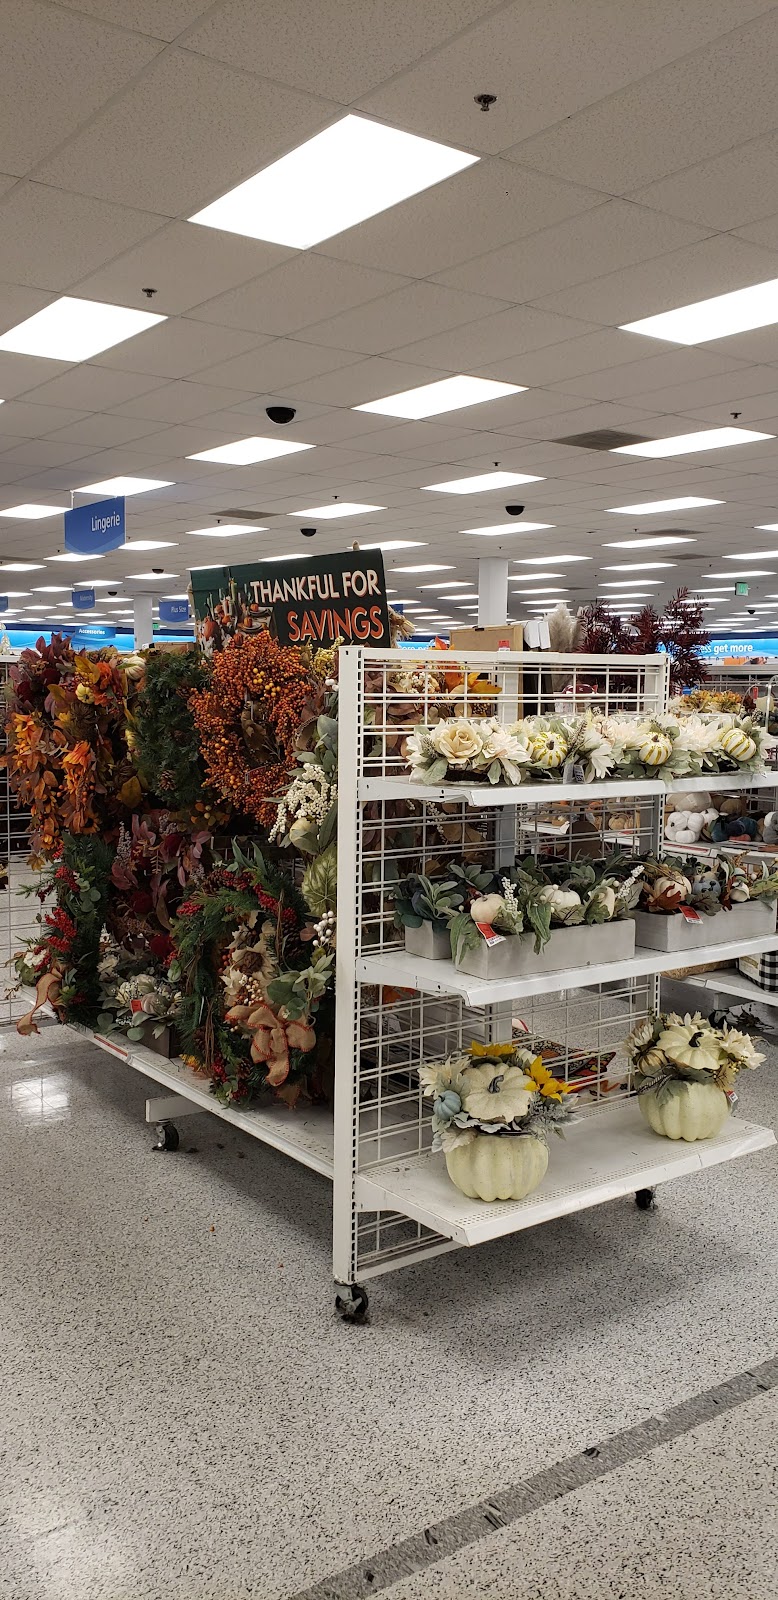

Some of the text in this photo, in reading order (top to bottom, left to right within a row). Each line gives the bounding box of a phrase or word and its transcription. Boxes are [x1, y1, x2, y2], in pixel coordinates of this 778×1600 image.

[91, 511, 120, 533] Lingerie
[250, 569, 381, 603] THANKFUL FOR
[287, 606, 384, 641] SAVINGS
[713, 644, 728, 655] get
[730, 644, 753, 653] more
